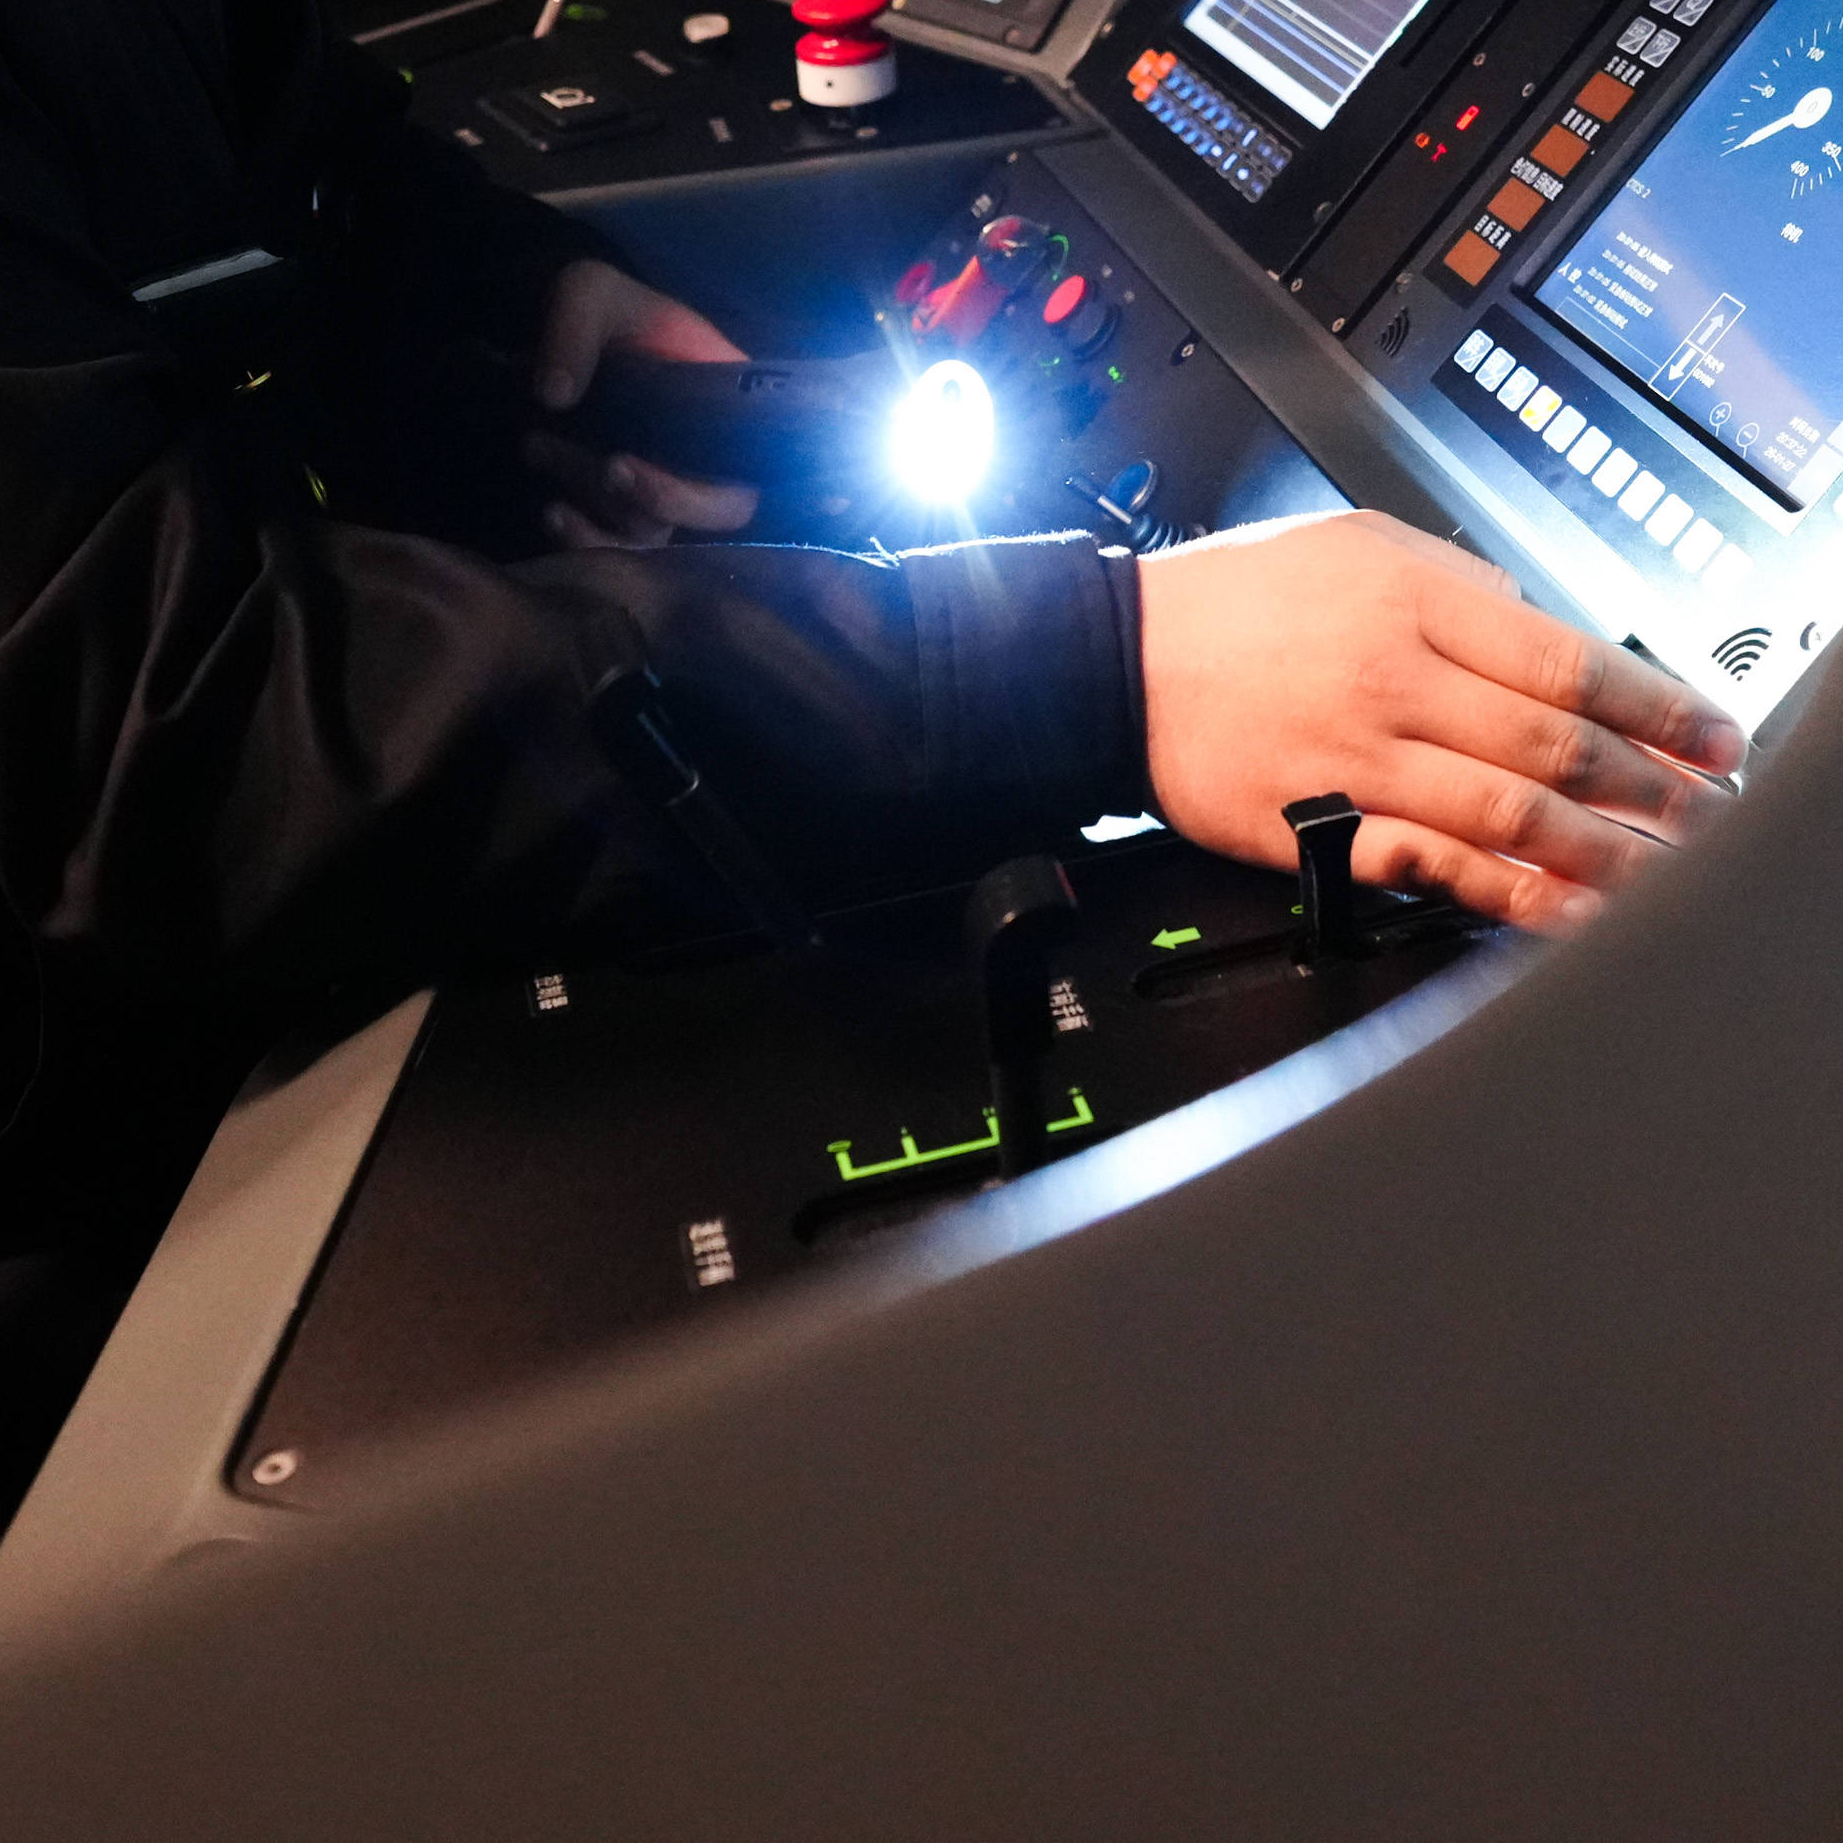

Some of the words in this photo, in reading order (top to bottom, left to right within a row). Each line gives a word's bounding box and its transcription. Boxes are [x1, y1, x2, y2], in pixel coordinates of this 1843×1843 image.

[1806, 46, 1825, 62] 100
[1761, 84, 1776, 99] 50
[1821, 141, 1842, 157] 350
[1790, 160, 1810, 177] 400
